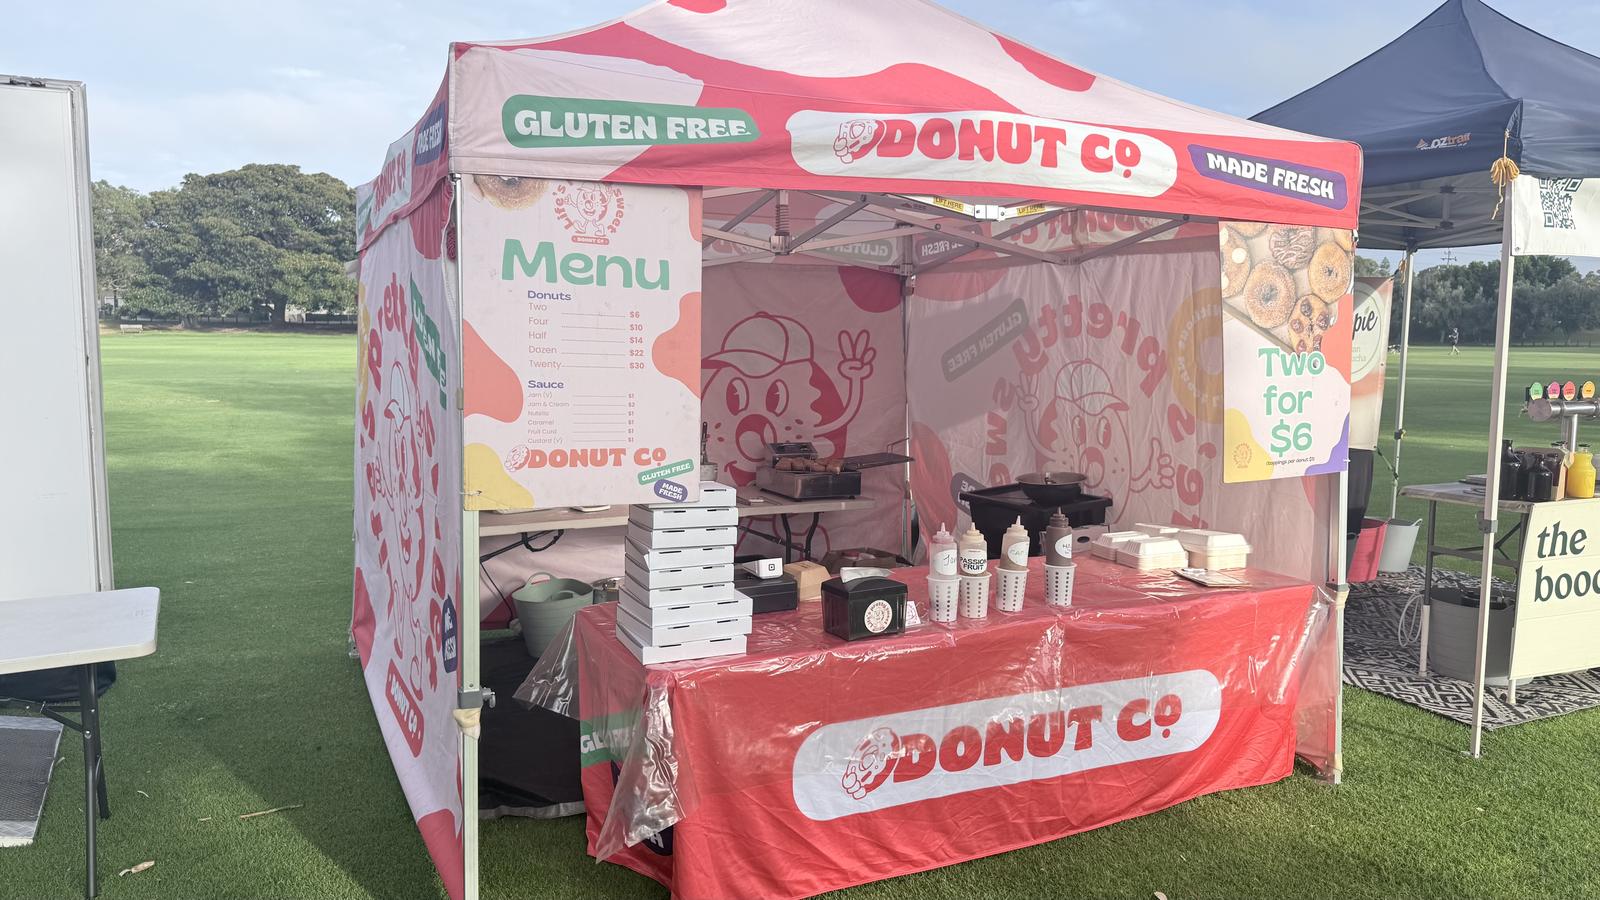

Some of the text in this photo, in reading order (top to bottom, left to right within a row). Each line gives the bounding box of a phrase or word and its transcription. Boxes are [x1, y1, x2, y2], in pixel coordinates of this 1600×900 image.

[514, 109, 751, 140] GLUTEN FREE
[876, 117, 1068, 169] DONUT
[1206, 151, 1335, 201] MADE FRESH
[607, 188, 625, 234] sweet
[934, 197, 964, 210] LIFT HERE
[501, 241, 670, 291] Menu
[527, 289, 571, 301] Donuts
[528, 302, 640, 320] Two $6
[528, 316, 644, 333] Four $10
[1352, 310, 1378, 341] pie
[528, 331, 644, 346] Half $14
[528, 345, 644, 358] Dozen $22
[1258, 347, 1325, 377] Two
[529, 359, 645, 371] Twenty $30
[527, 379, 564, 389] Sauce
[1263, 384, 1312, 415] for
[1270, 418, 1312, 458] $6
[528, 449, 627, 469] DONUT
[641, 462, 691, 482] GLUTEN FREE
[658, 488, 683, 501] FRESH
[661, 482, 683, 495] MADE
[1537, 520, 1587, 559] the
[391, 673, 410, 724] DONUT
[893, 705, 1103, 783] DONUT
